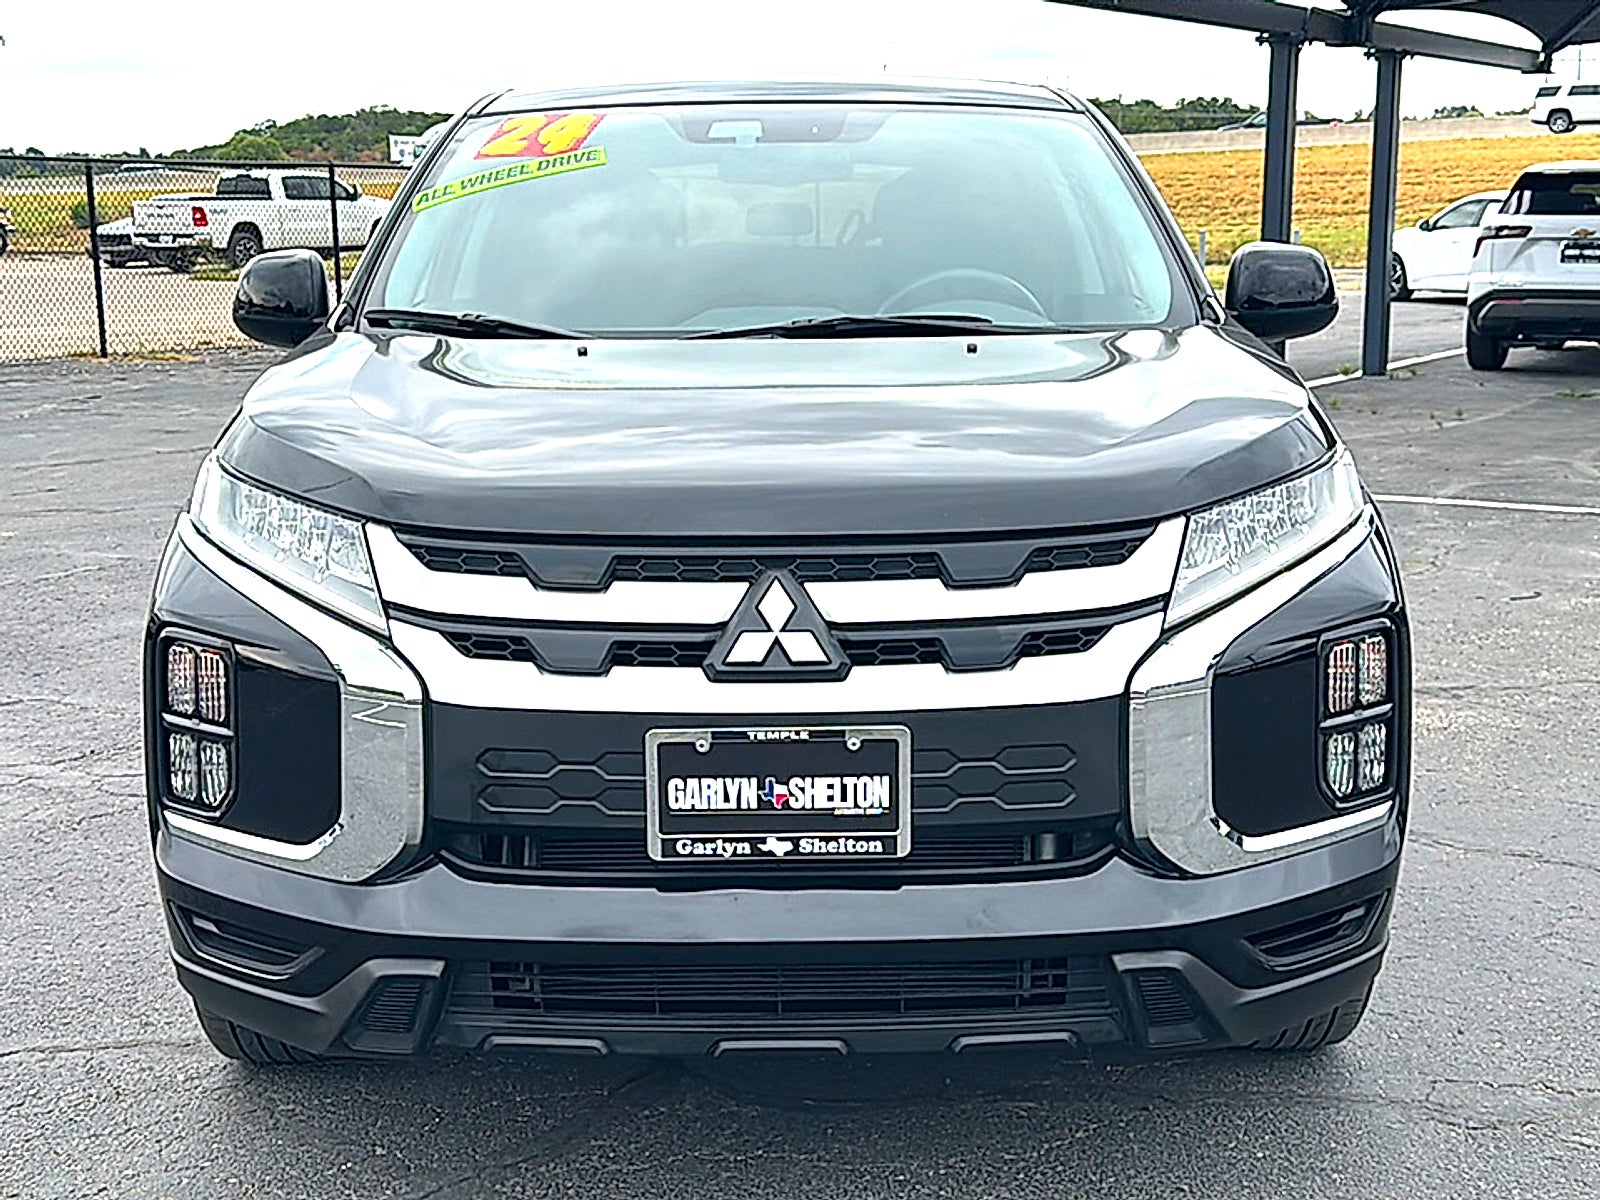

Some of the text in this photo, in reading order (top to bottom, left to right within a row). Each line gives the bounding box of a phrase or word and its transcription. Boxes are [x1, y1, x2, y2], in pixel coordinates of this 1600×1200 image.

[478, 113, 598, 156] 24
[416, 148, 600, 207] ALL WHEEL DRIVE
[746, 730, 810, 740] TEMPLE
[667, 775, 890, 809] GARLYN SHELTON
[675, 837, 883, 858] Garlyn Shelton
